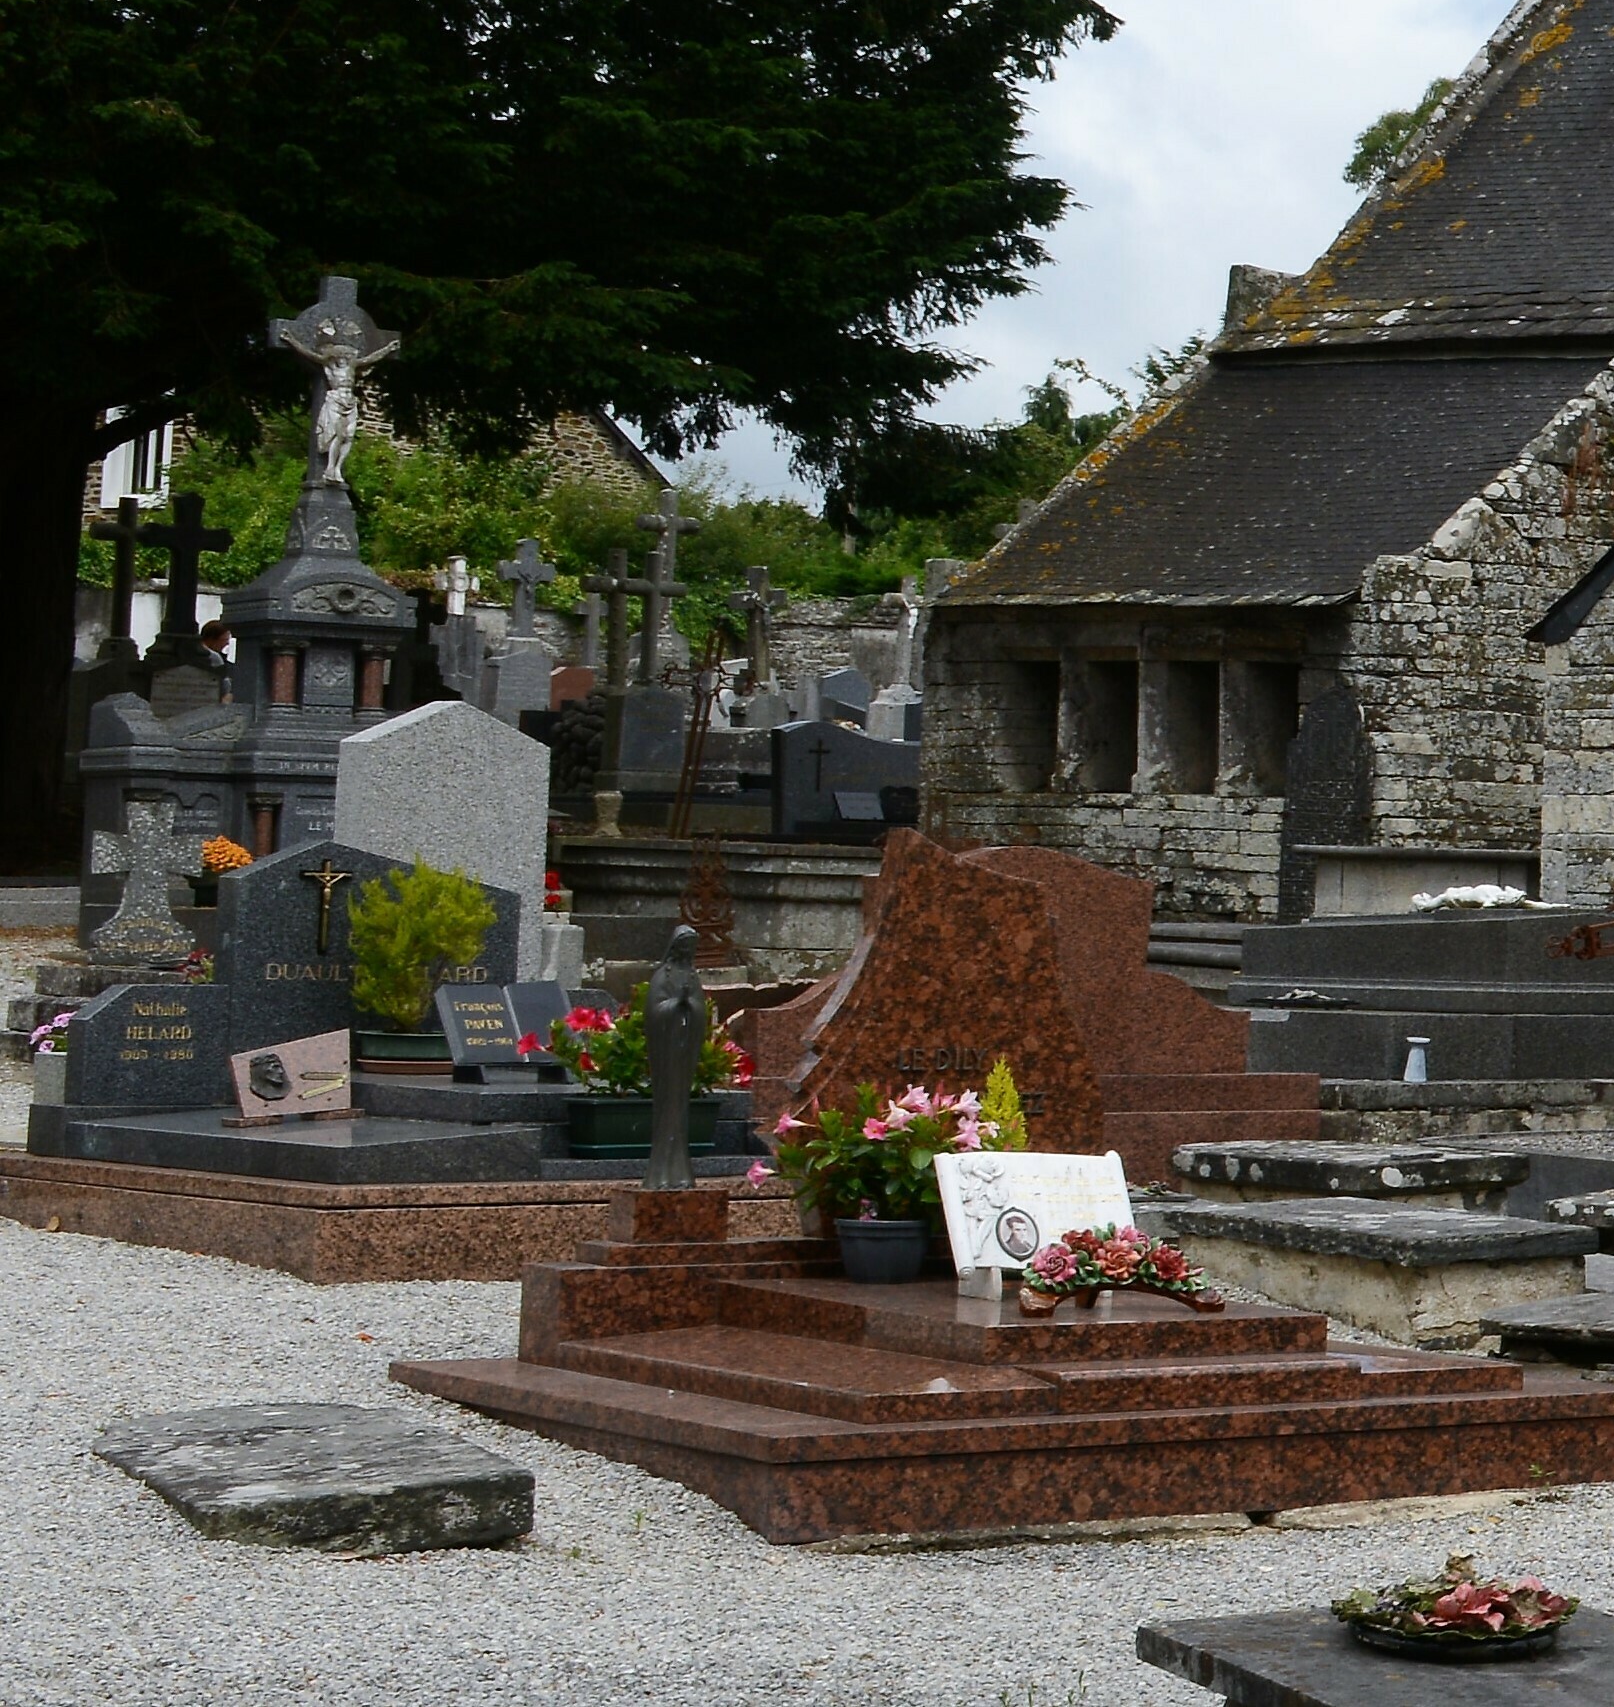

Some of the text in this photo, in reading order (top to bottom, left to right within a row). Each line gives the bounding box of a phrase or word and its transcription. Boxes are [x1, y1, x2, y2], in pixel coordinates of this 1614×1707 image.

[133, 1002, 187, 1016] Nathalie
[897, 1047, 987, 1071] LE DILY
